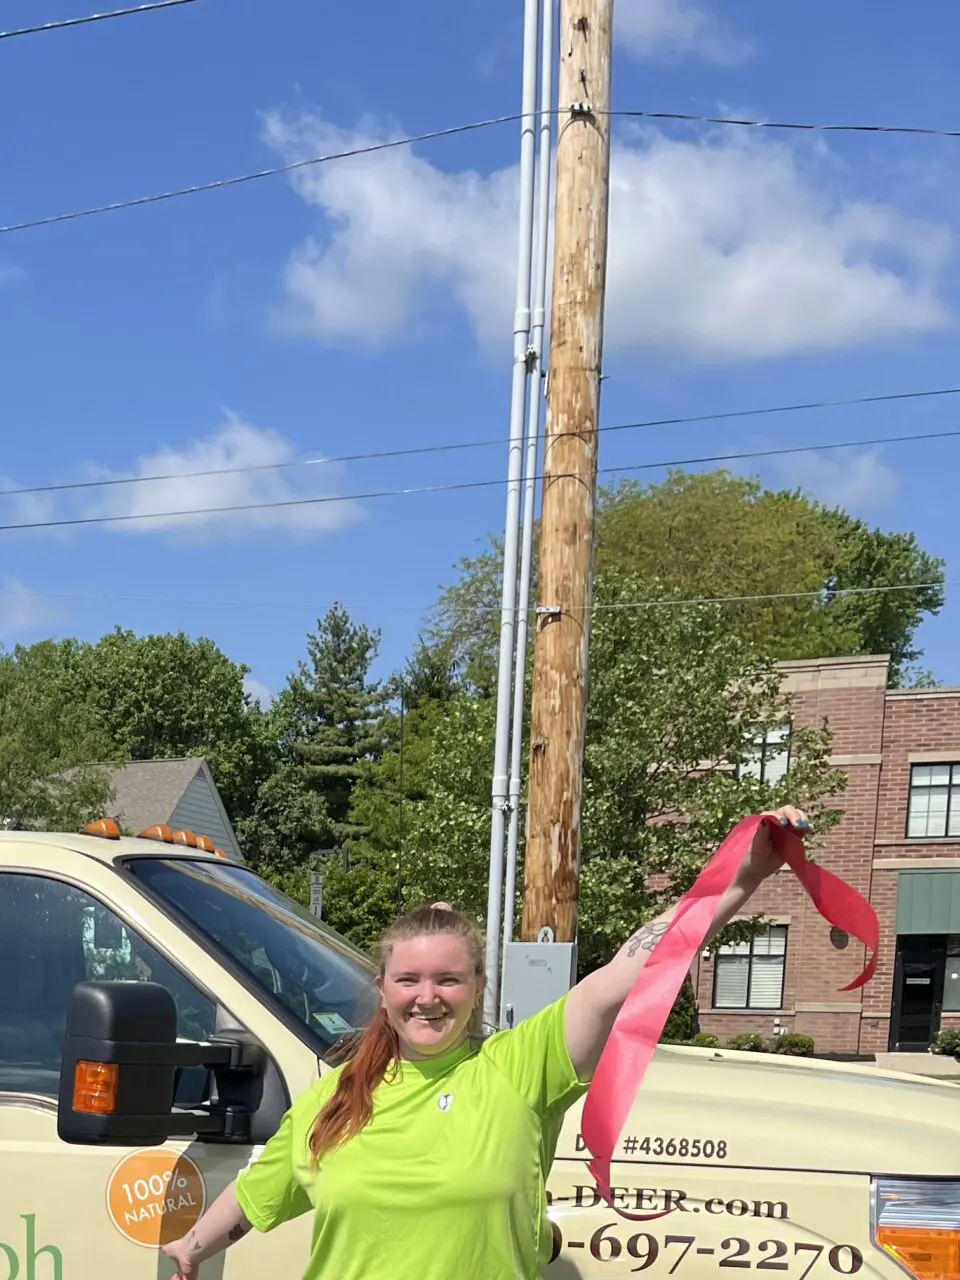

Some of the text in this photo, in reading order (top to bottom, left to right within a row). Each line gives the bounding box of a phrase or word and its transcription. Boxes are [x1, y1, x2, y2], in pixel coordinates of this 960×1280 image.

[623, 1136, 728, 1159] #4368508
[121, 1167, 188, 1205] 100%
[123, 1192, 197, 1226] NATURAL
